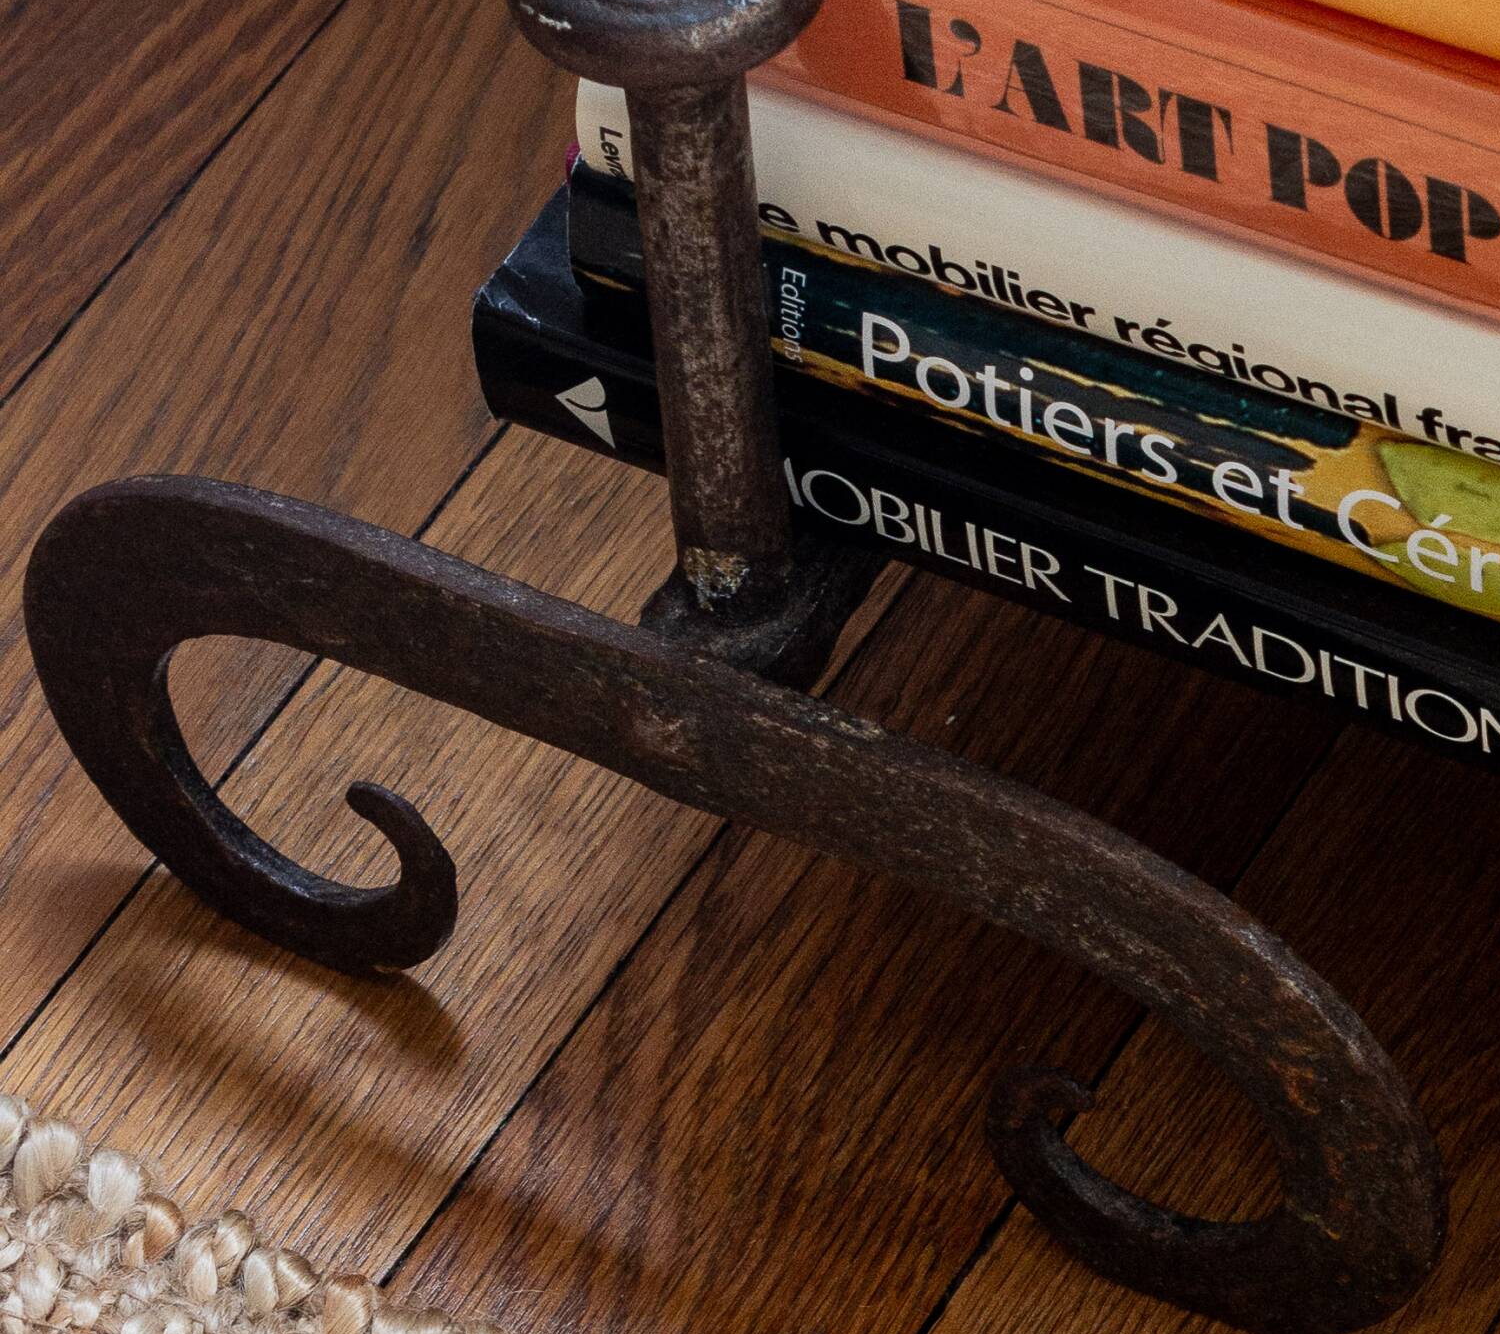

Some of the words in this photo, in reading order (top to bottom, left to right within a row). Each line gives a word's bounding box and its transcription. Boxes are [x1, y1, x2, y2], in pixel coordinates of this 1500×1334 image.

[756, 200, 801, 234] e
[815, 221, 1096, 327] mobilier
[1113, 318, 1400, 431] régional
[780, 265, 808, 365] Editions
[858, 311, 1177, 485] Potiers
[1211, 456, 1308, 533] et
[782, 456, 1073, 604] OBILIER
